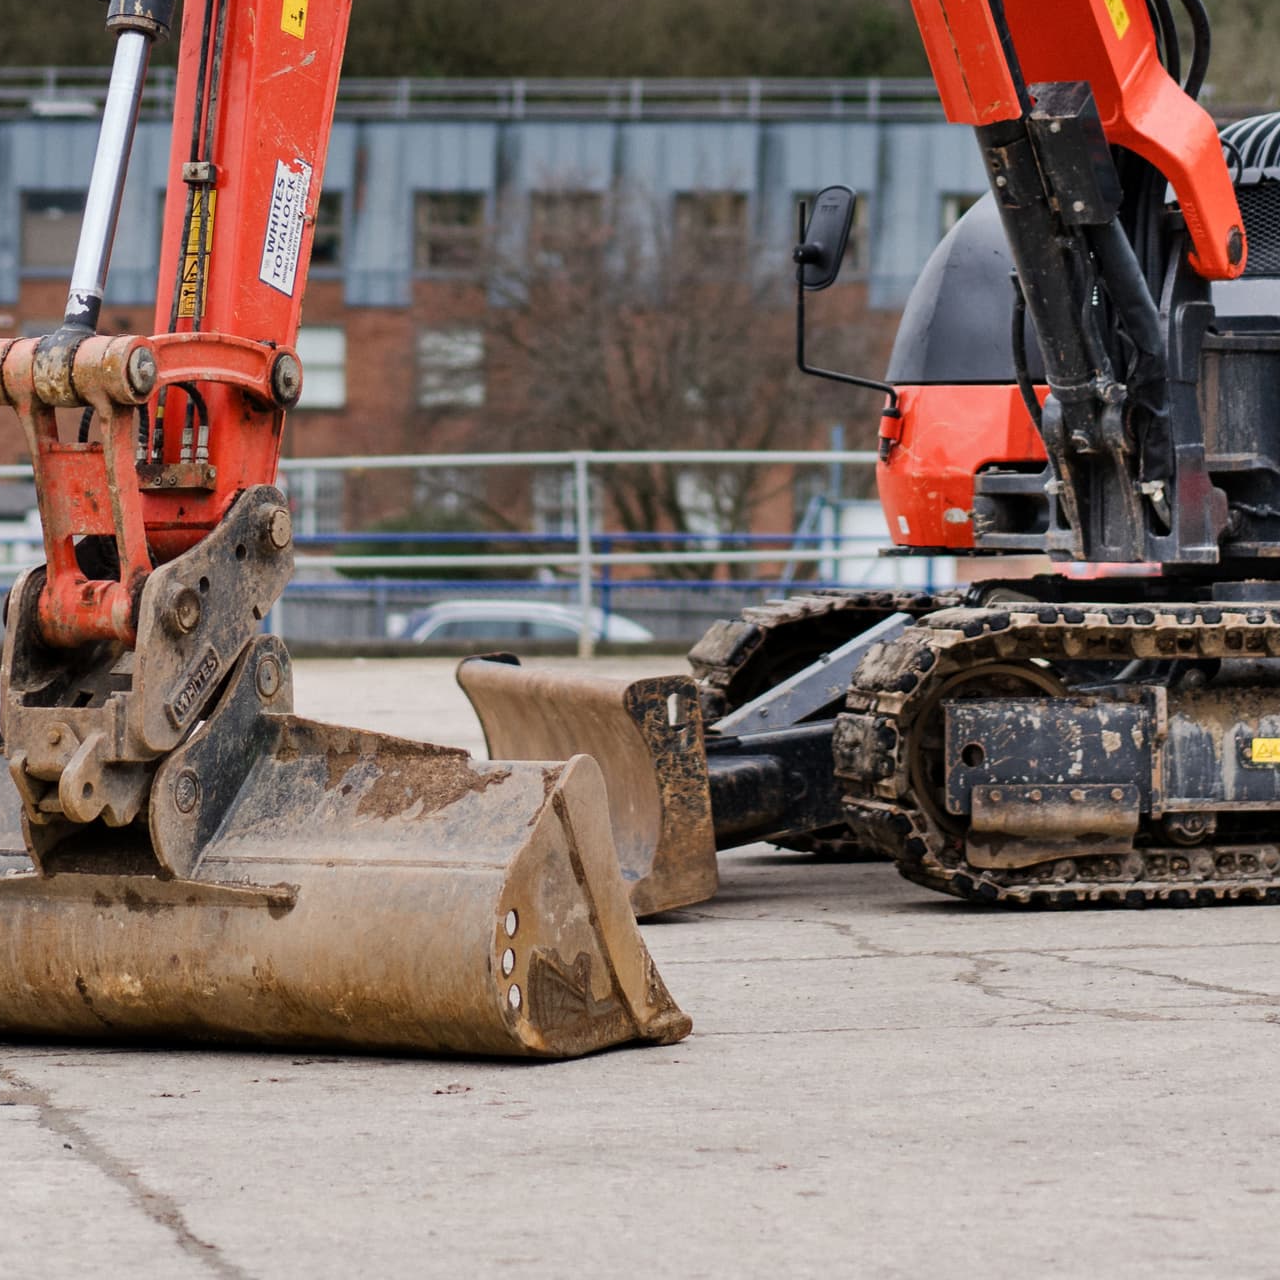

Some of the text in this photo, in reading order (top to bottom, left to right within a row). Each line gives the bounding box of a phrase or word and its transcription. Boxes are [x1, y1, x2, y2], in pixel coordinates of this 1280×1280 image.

[266, 176, 285, 254] WHITES
[272, 176, 295, 280] TOTALOCK
[174, 655, 217, 721] WHITES
